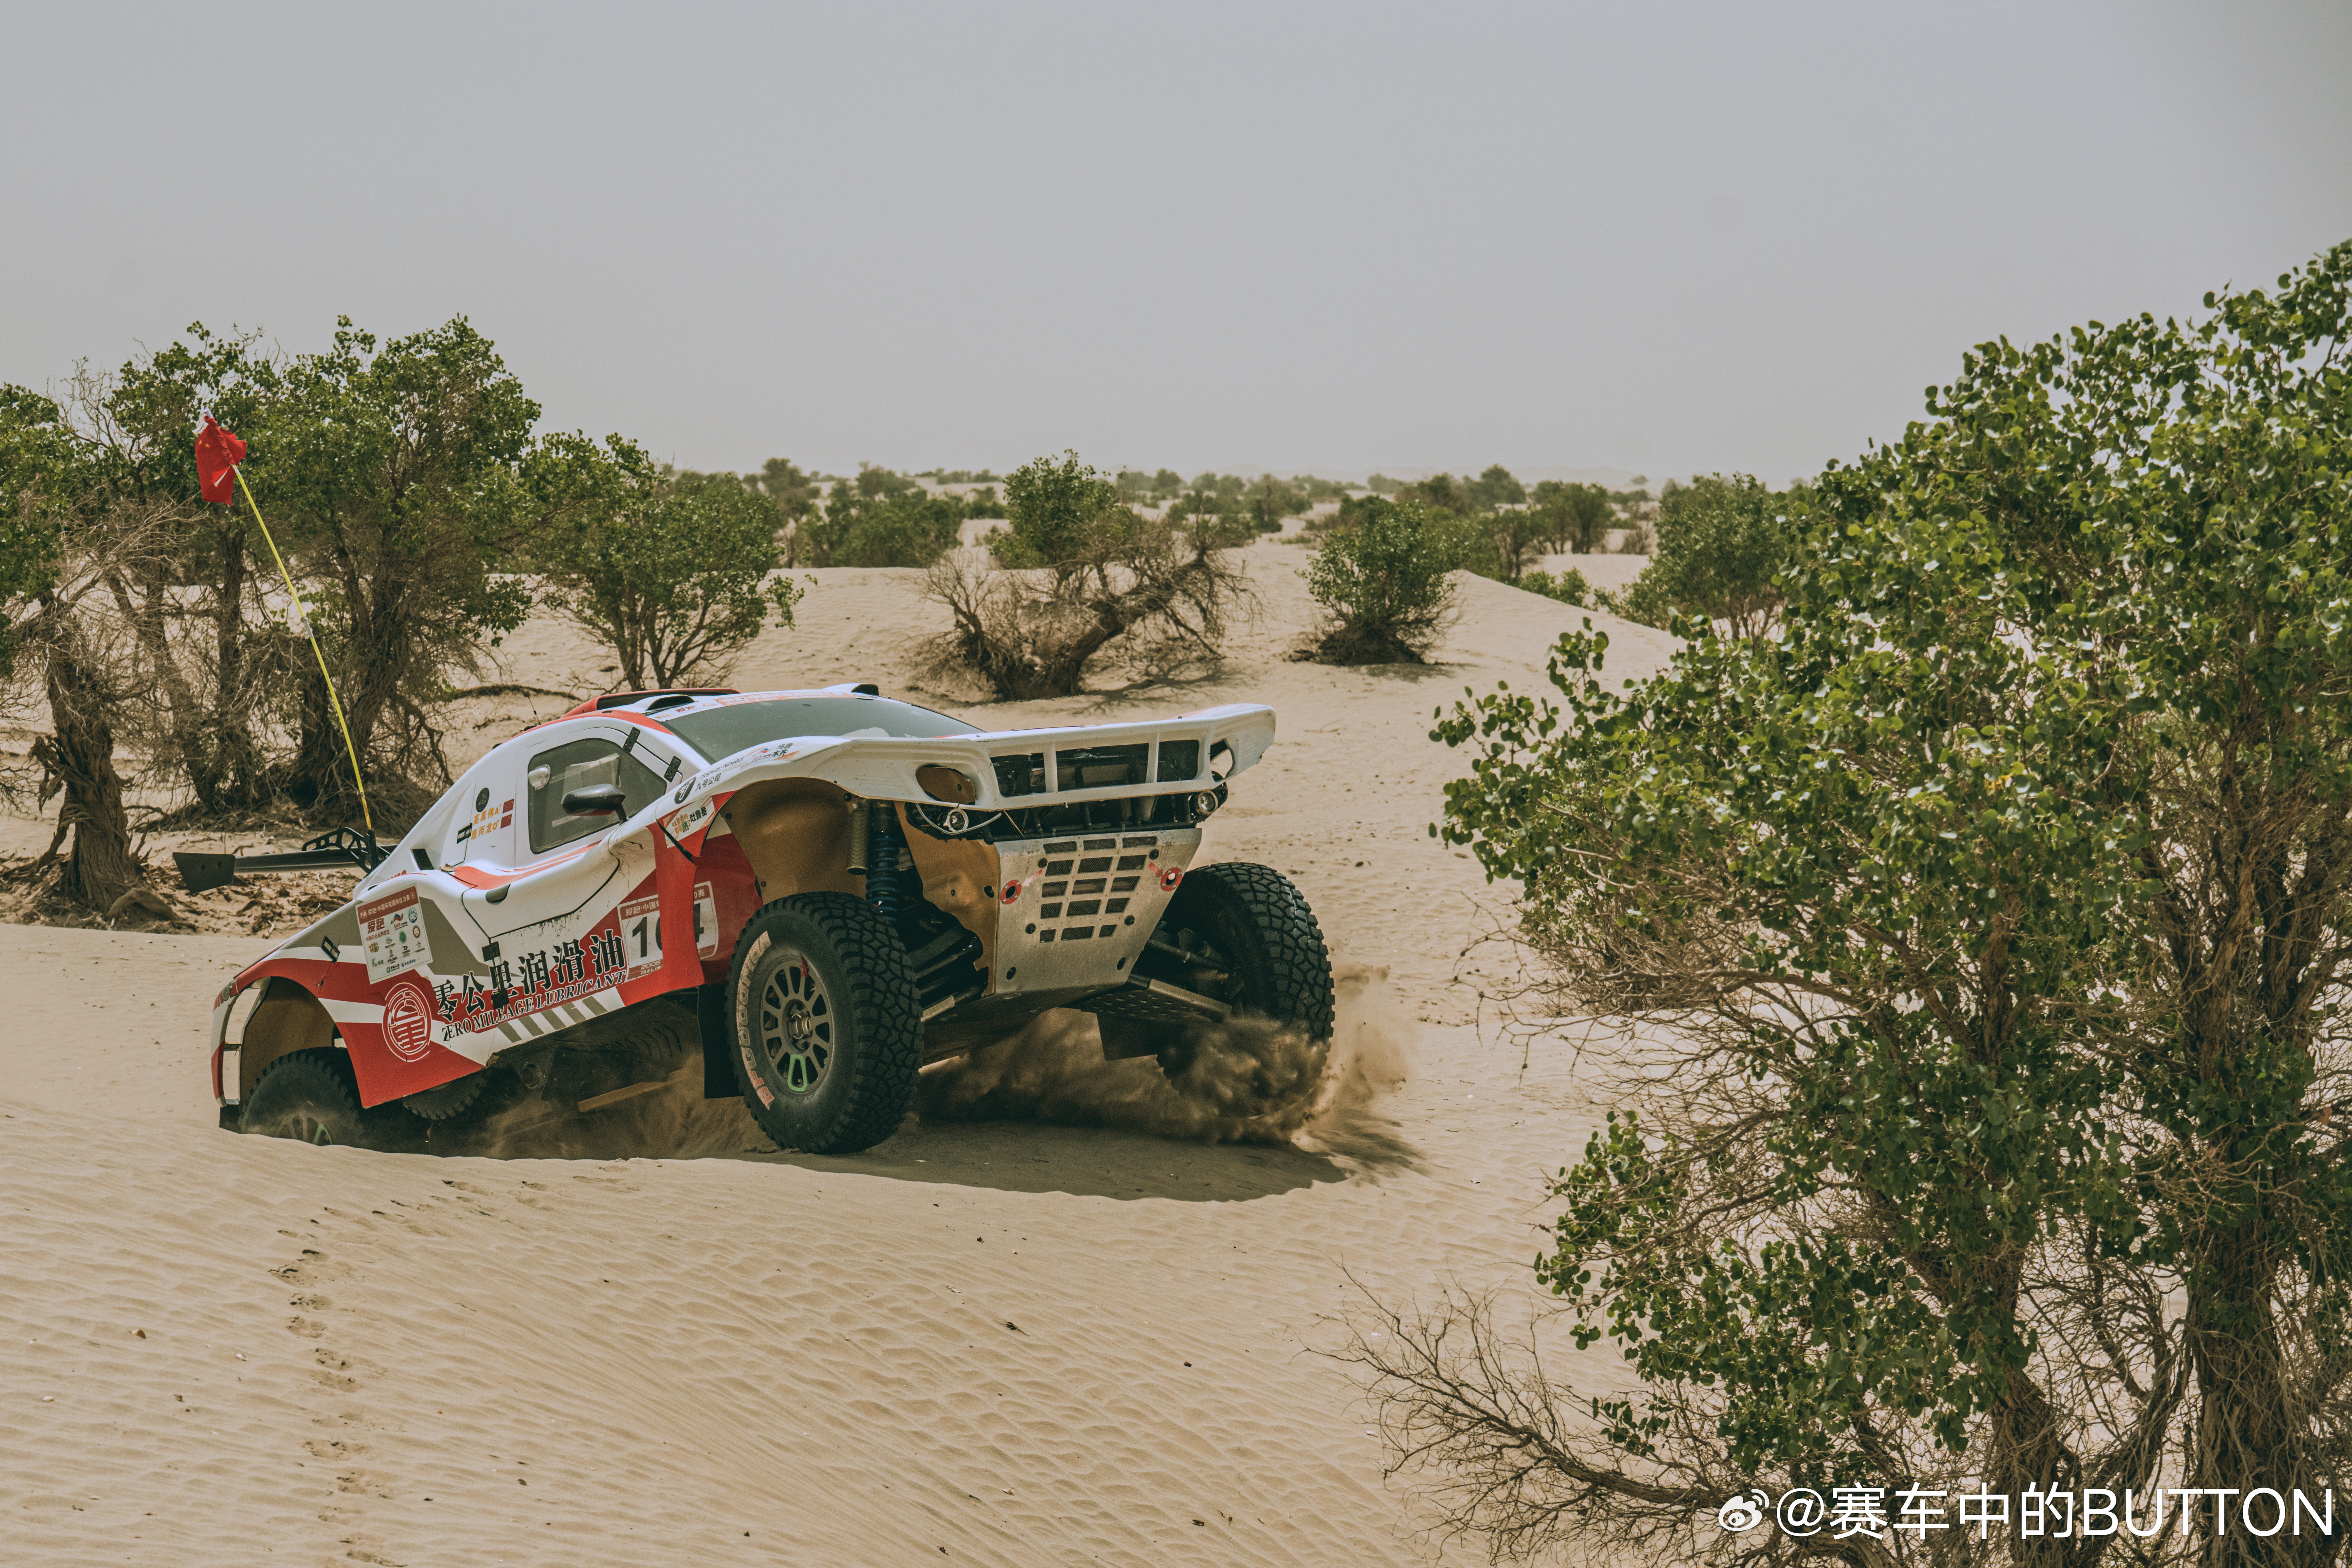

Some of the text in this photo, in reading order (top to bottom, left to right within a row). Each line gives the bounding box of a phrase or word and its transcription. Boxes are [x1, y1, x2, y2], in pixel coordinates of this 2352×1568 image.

[771, 749, 788, 757] 木齐
[700, 756, 745, 780] Segway-Ninebot
[695, 773, 722, 792] 九号公司
[689, 806, 708, 822] 吐鲁番
[367, 917, 385, 934] 爱跑
[434, 929, 626, 1022] 零公里润滑油
[442, 969, 627, 1042] ZERO MILEAGE LUBRICANT
